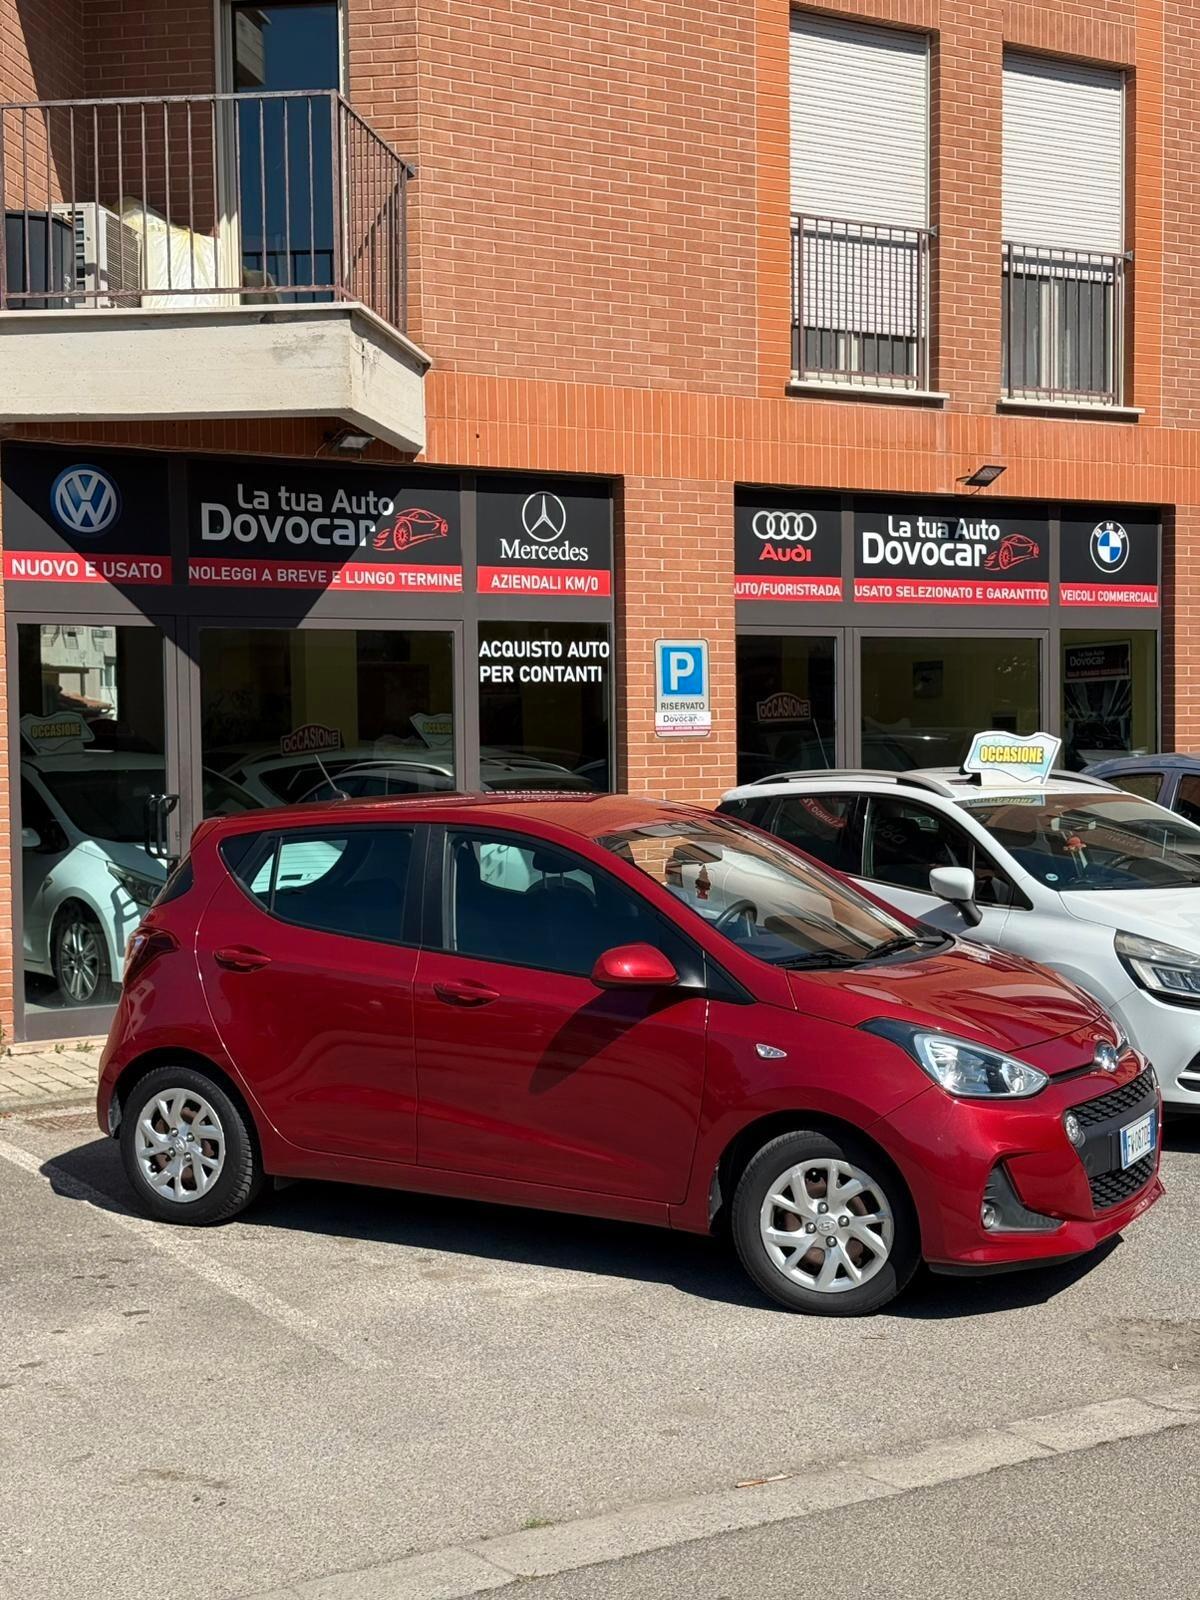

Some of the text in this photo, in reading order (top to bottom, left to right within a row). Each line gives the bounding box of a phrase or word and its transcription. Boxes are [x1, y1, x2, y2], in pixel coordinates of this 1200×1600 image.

[237, 483, 394, 515] La tua Auto
[201, 502, 376, 547] Dovocar
[888, 515, 1000, 541] La tua Auto
[1093, 522, 1127, 540] BMW
[500, 538, 589, 562] Mercedes
[759, 542, 812, 562] Audi
[862, 531, 987, 567] Dovocar
[11, 558, 163, 579] NUOVO E USATO
[188, 566, 462, 587] NOLEGGI A BREVE E LUNGO TERMINE
[491, 573, 599, 593] AZIENDALI KM/0
[734, 582, 840, 597] UTO/FUORISTRADA
[855, 584, 1048, 600] USATO SELEZIONATO E GARANTITO
[1061, 589, 1158, 604] VEICOLI COMMERCIALI
[479, 640, 610, 660] ACQUISTO AUTO
[480, 665, 602, 683] PER CONTANTI
[669, 651, 695, 691] P
[660, 701, 705, 711] RISERVATO
[760, 695, 809, 719] OCCASIONE
[31, 722, 81, 738] OCCASIONE
[282, 728, 339, 752] OCCASIONE
[980, 745, 1044, 764] OCCASIONE
